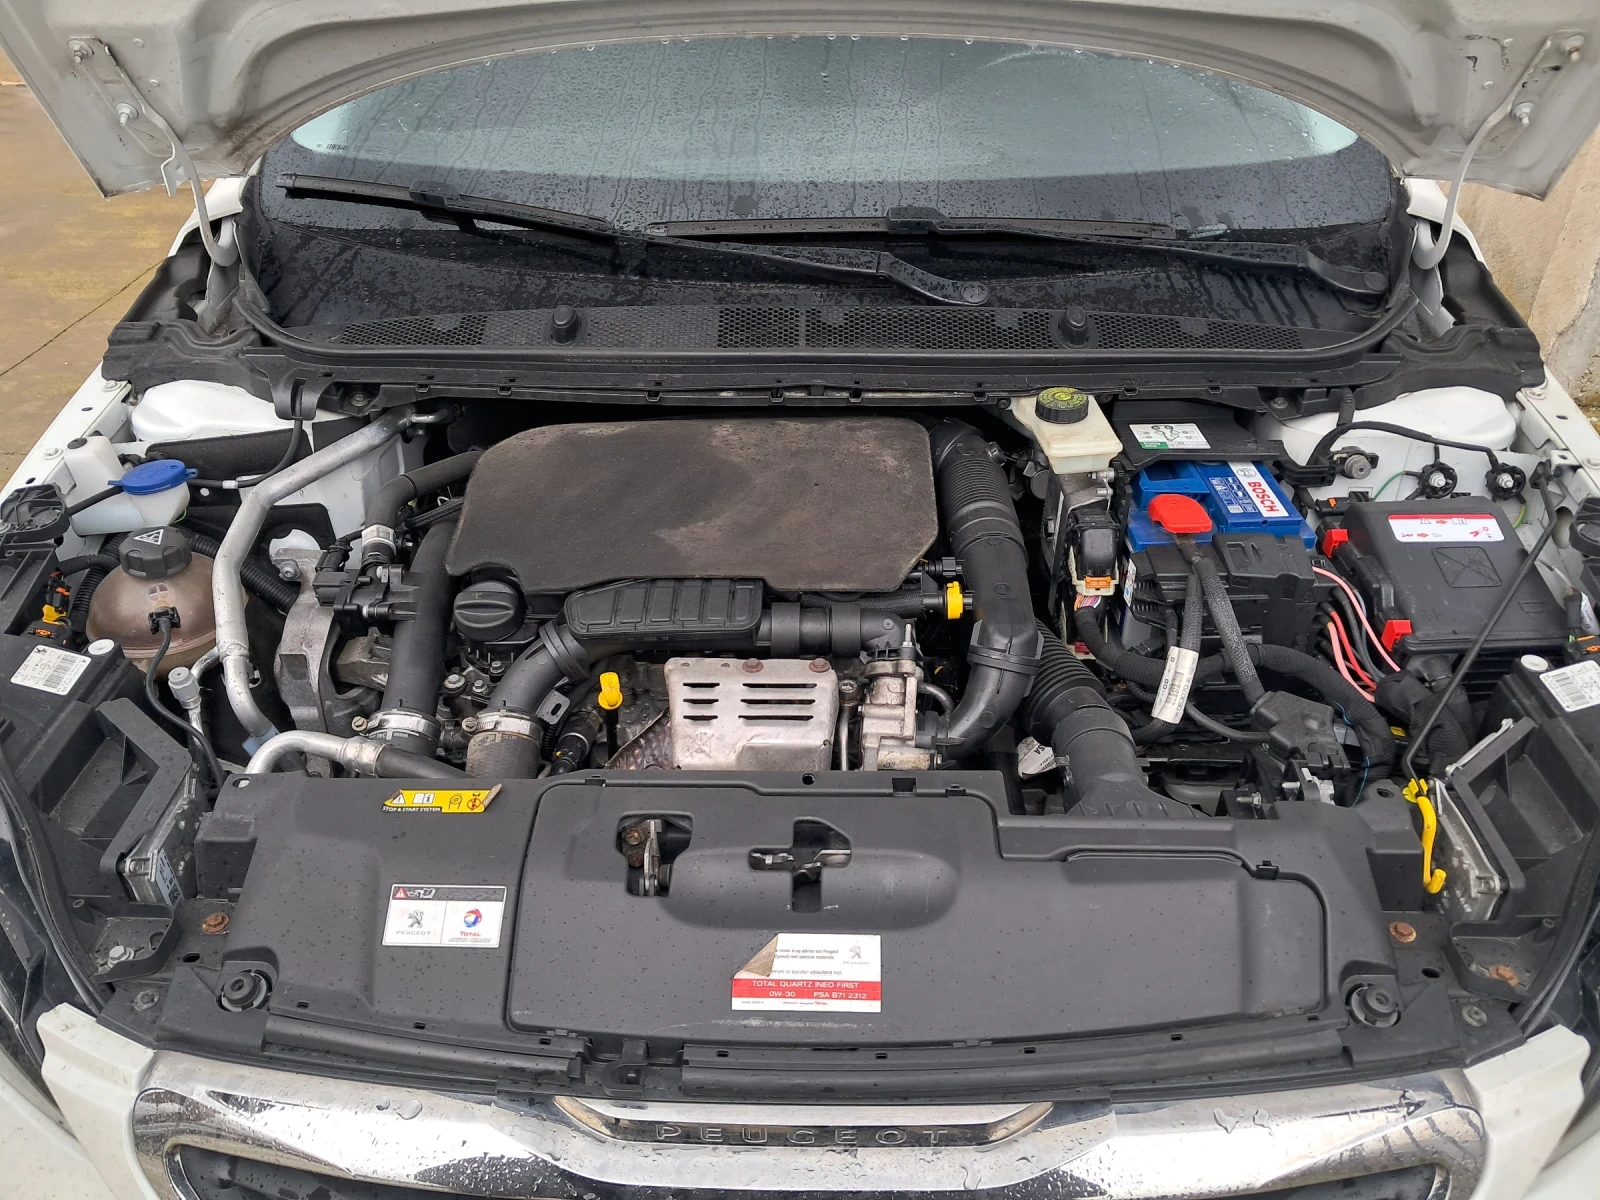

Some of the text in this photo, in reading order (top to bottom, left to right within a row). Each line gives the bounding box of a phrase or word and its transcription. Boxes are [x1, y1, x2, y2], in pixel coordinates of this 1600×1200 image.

[1247, 481, 1280, 512] BOSCH
[779, 980, 813, 988] QUARTZ
[655, 1125, 949, 1145] PEUGEOT
